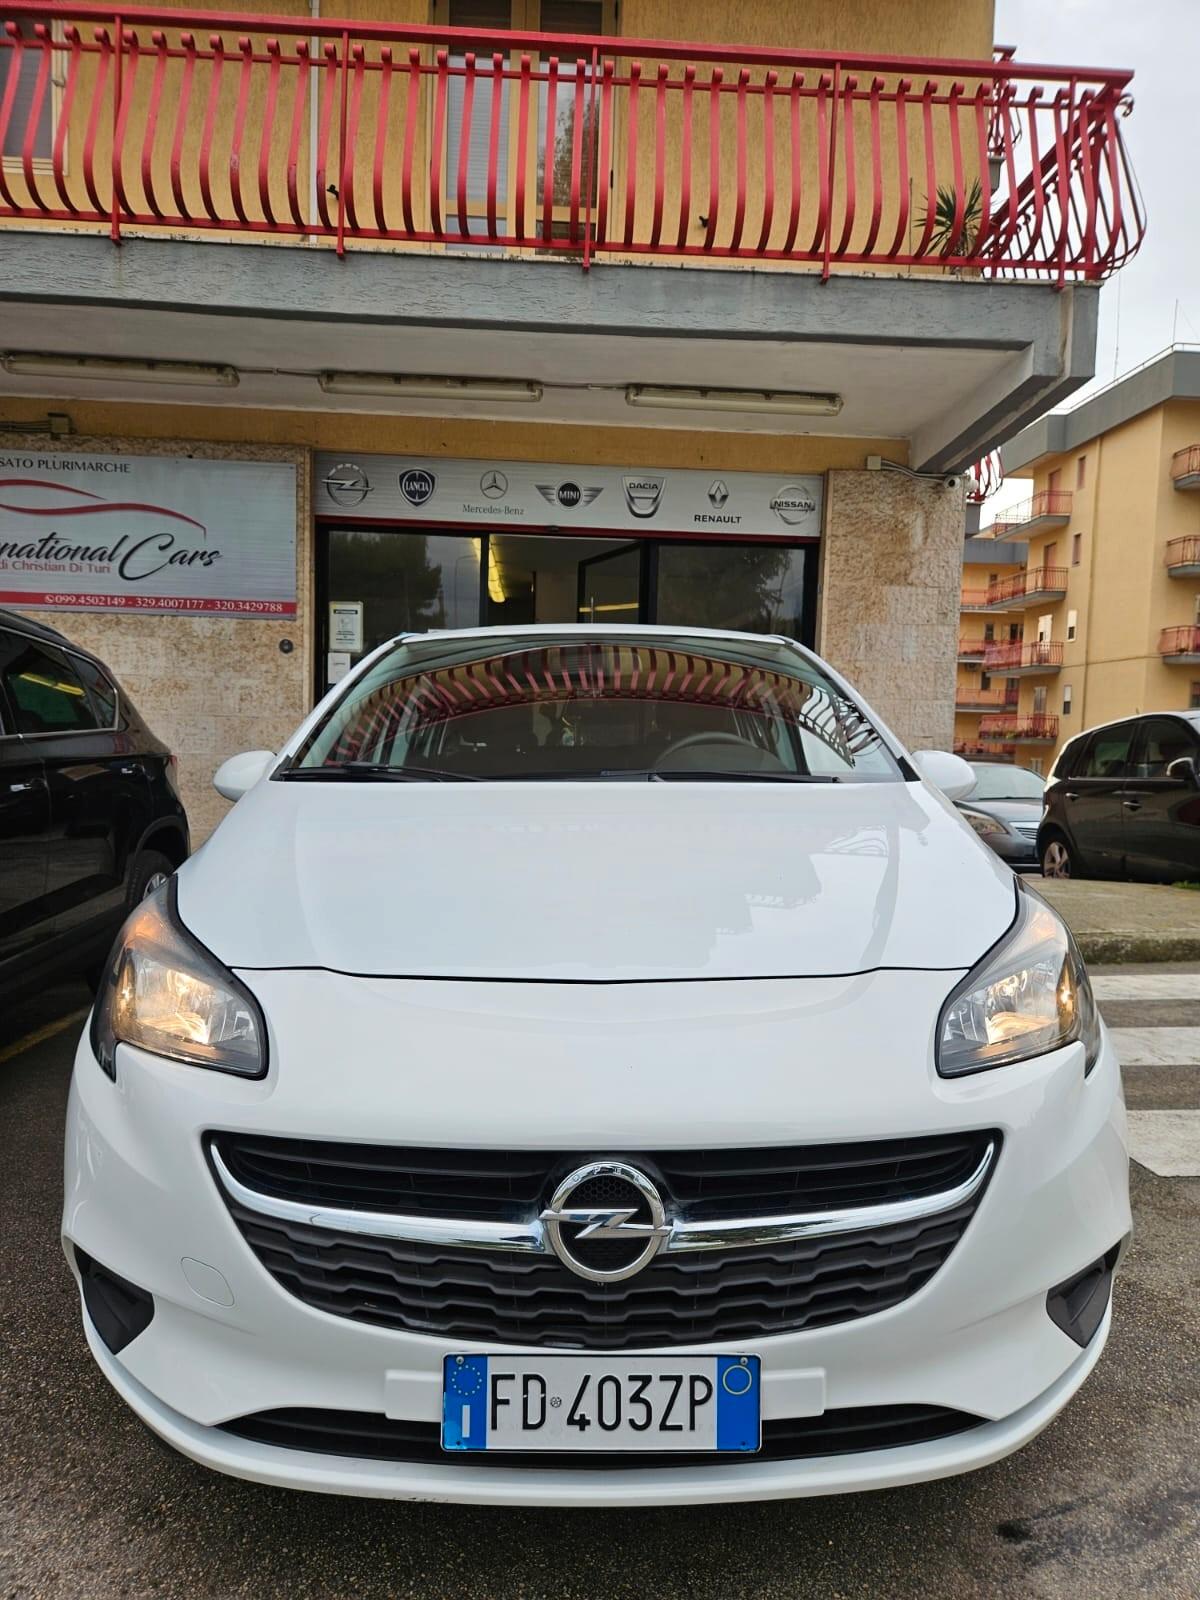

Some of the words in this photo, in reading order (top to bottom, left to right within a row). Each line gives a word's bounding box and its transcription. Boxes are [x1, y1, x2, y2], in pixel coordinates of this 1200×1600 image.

[38, 459, 131, 473] PLURIMARCHE
[405, 481, 429, 492] LANCIA
[629, 482, 659, 490] DACIA
[559, 490, 580, 500] MINI
[462, 504, 524, 515] Mercedes-Benz
[694, 514, 742, 523] RENAULT
[118, 532, 222, 580] Cars
[12, 560, 64, 572] Christian
[69, 563, 82, 573] Di
[86, 563, 110, 574] Turi
[55, 595, 125, 606] 099.4502149
[135, 597, 204, 609] 329.4007177
[215, 600, 283, 612] 320.3429788
[490, 1373, 547, 1430] FD
[566, 1374, 713, 1431] 403ZP
